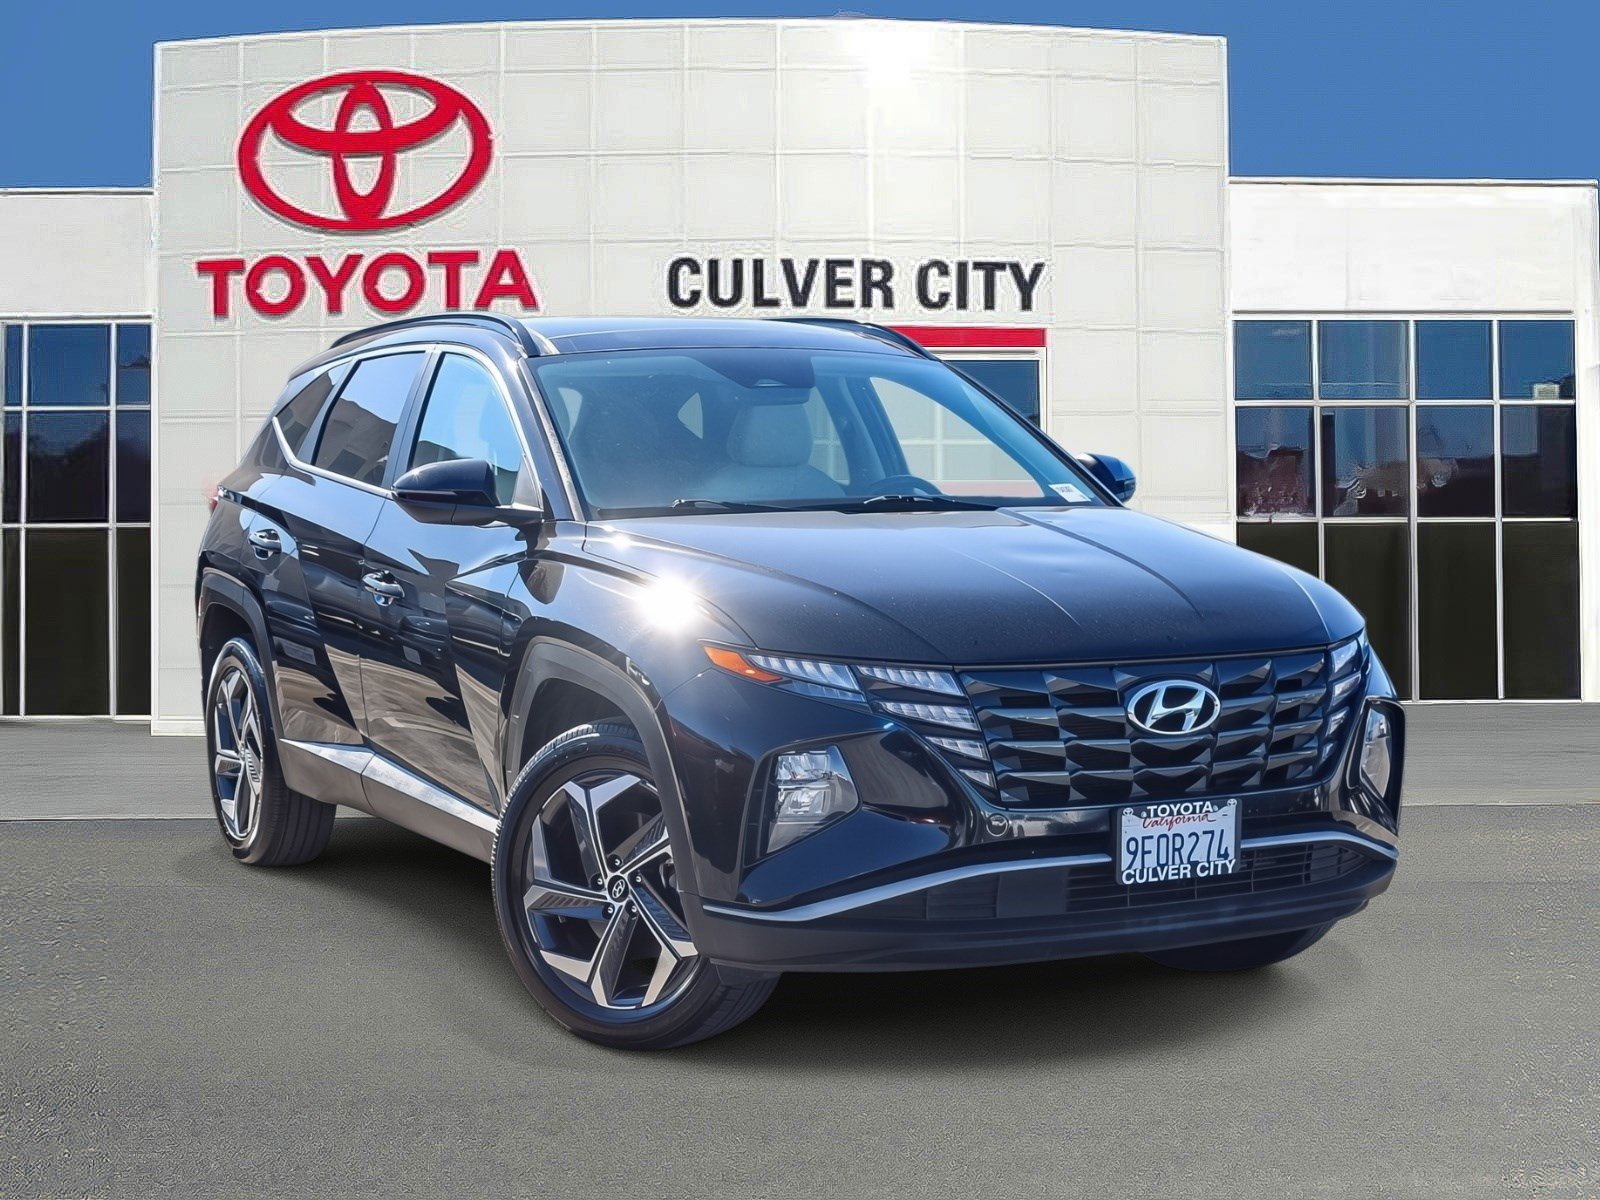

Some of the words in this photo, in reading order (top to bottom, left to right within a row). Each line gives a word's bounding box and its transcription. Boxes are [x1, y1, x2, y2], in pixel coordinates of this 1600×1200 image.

[195, 249, 538, 318] TOYOTA
[667, 257, 895, 309] CULVER
[916, 259, 1046, 311] CITY
[1142, 813, 1216, 831] California
[1147, 801, 1213, 818] TOYOTA
[1122, 864, 1191, 884] CULVER
[1196, 858, 1236, 877] CITY
